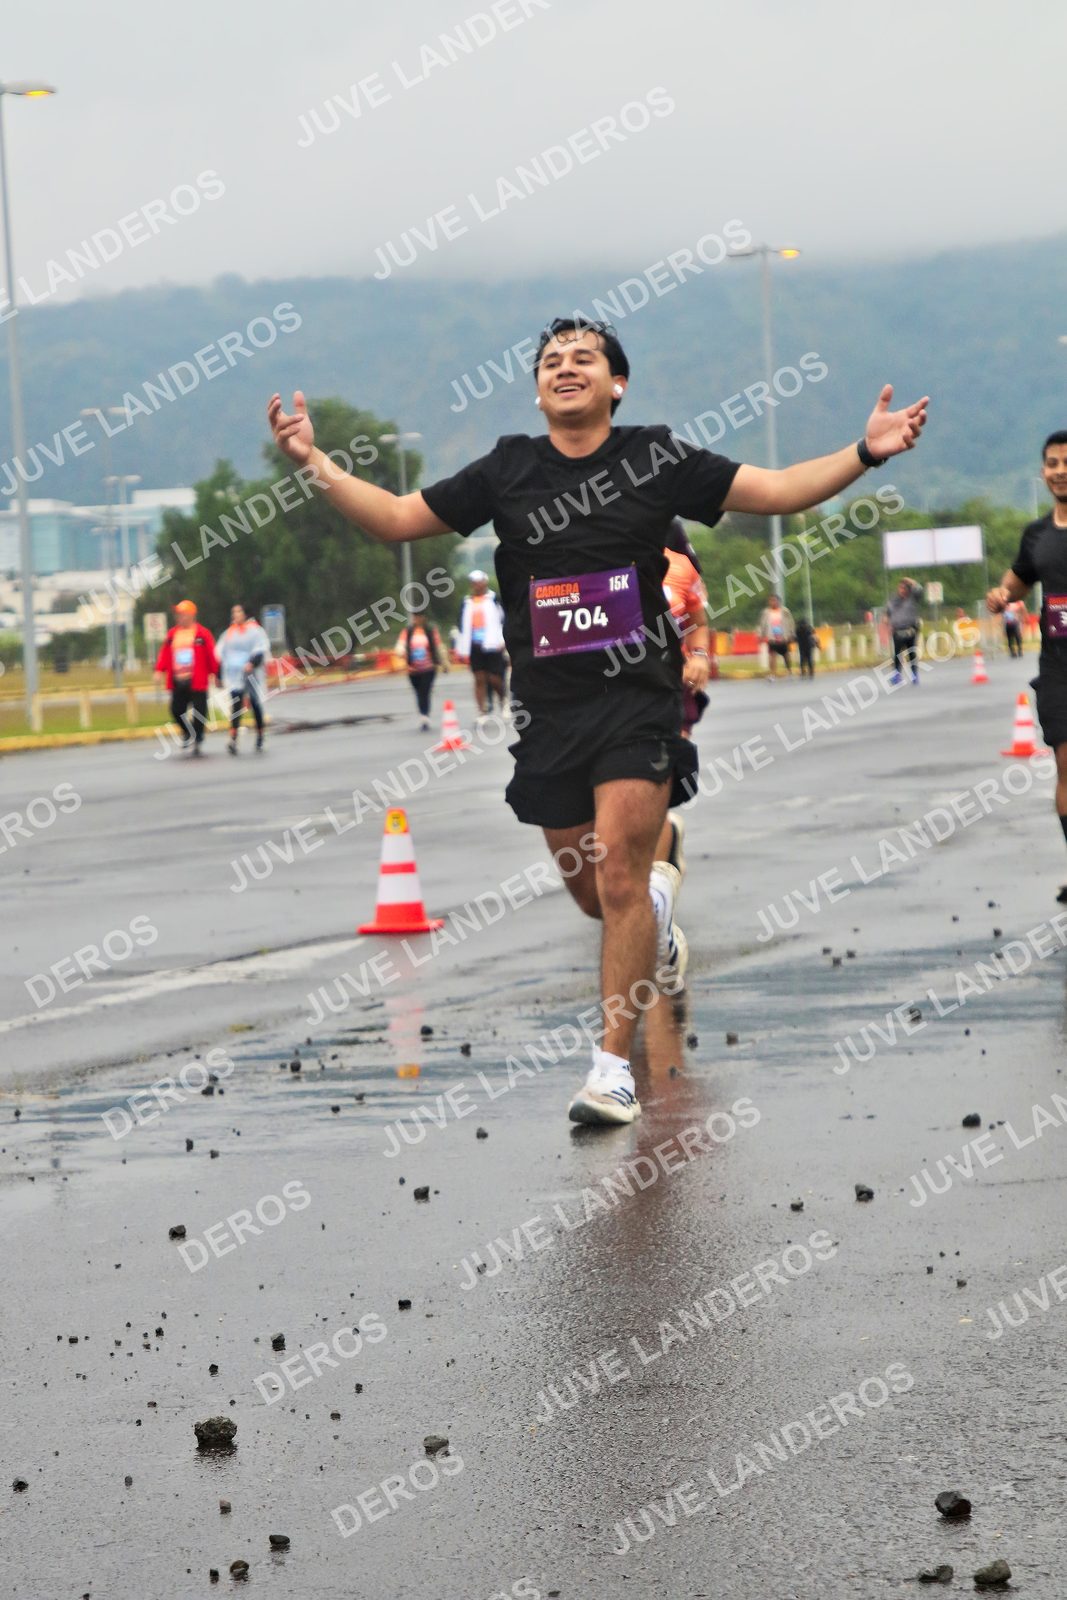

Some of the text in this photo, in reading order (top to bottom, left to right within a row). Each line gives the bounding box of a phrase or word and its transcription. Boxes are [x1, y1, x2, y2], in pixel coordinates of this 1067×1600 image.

[536, 582, 580, 598] CARRERA
[609, 574, 629, 592] 15K
[558, 605, 609, 632] 704
